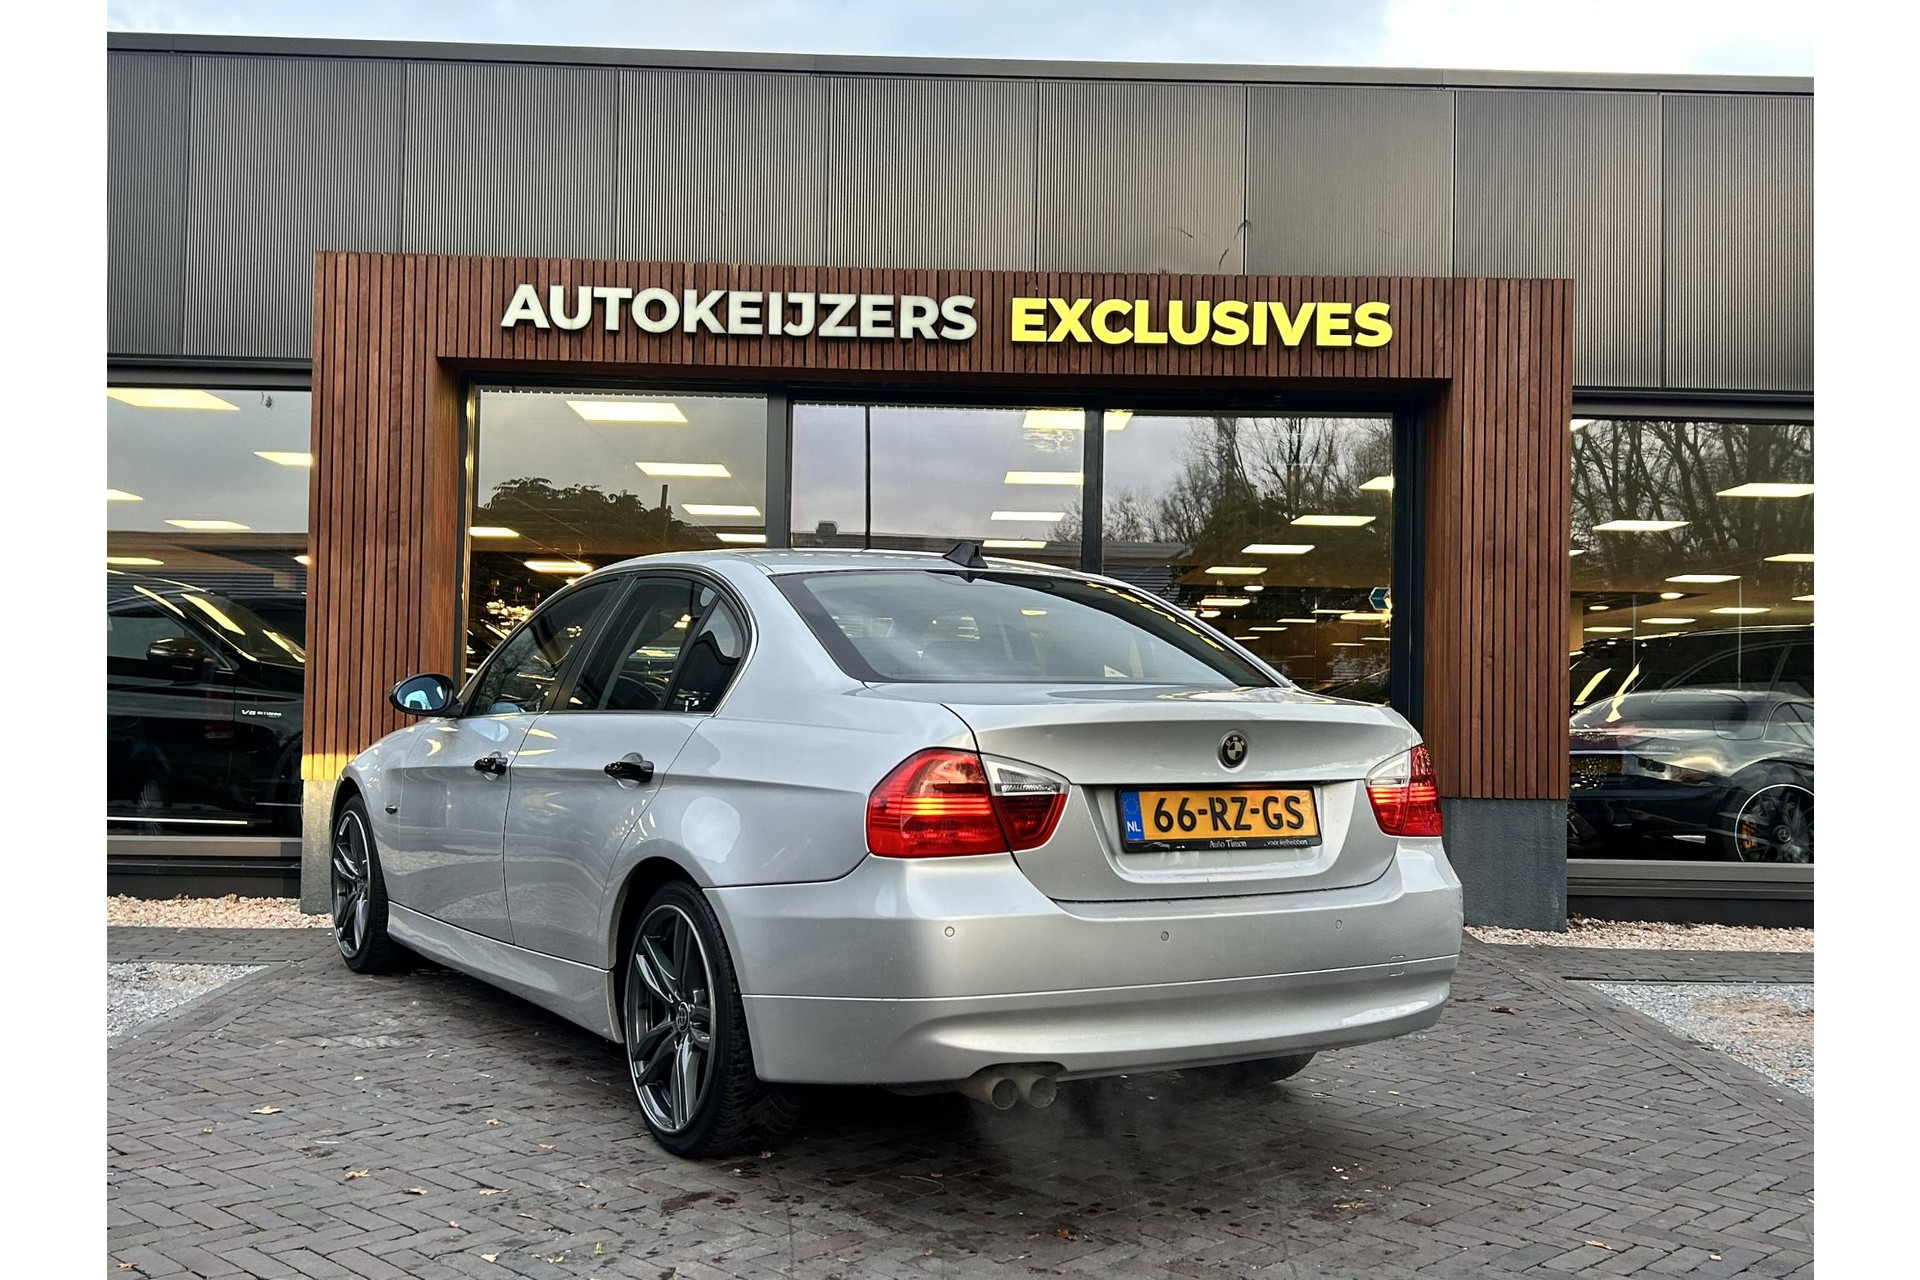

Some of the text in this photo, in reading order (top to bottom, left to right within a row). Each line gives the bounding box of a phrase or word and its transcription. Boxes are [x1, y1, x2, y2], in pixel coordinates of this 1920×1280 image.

[500, 283, 1393, 348] AUTOKEIJZERS EXCLUSIVES
[1126, 820, 1141, 832] NL
[1153, 795, 1305, 833] 66-RZ-GS
